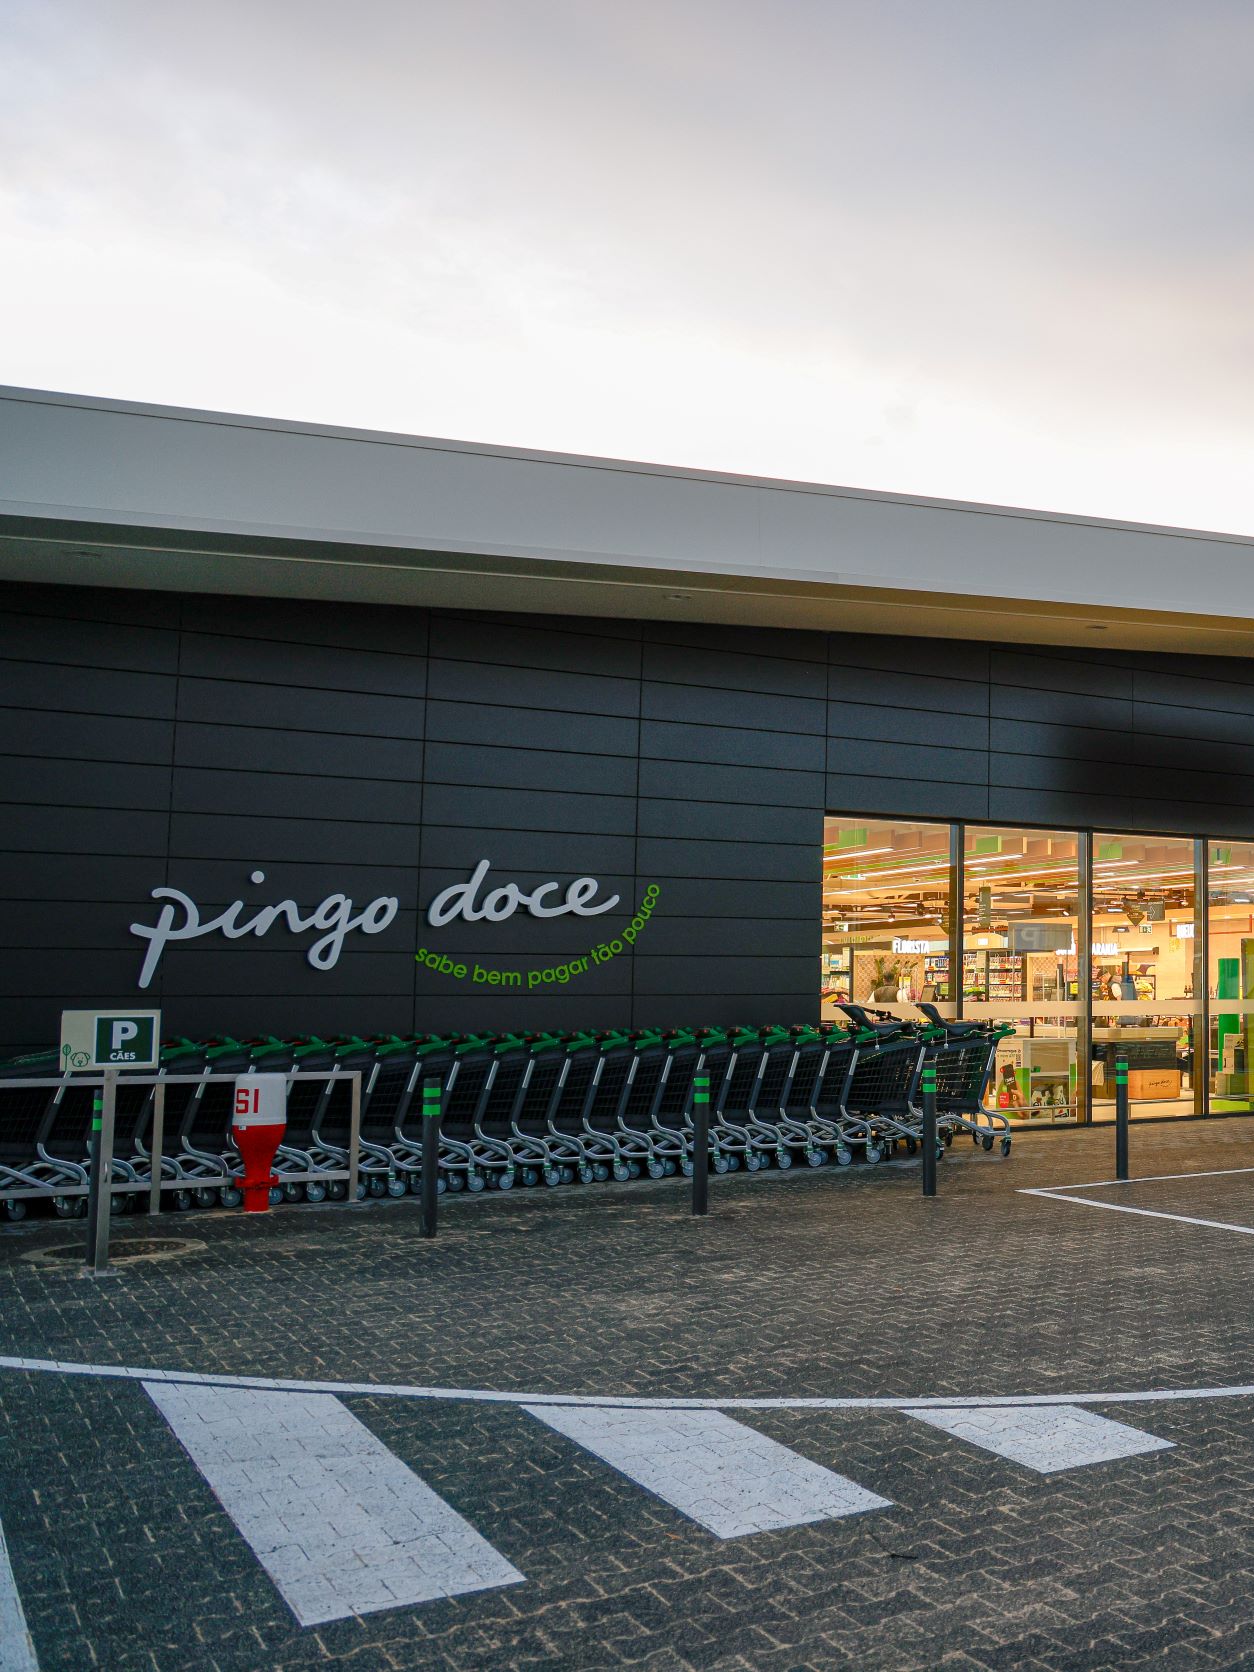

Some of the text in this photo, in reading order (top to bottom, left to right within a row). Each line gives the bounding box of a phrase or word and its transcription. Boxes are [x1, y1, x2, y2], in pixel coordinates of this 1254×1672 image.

[129, 858, 620, 989] pingo doce
[415, 883, 661, 989] sabe bem pagar tão pouco
[109, 1050, 136, 1061] CÃES
[111, 1020, 138, 1050] P
